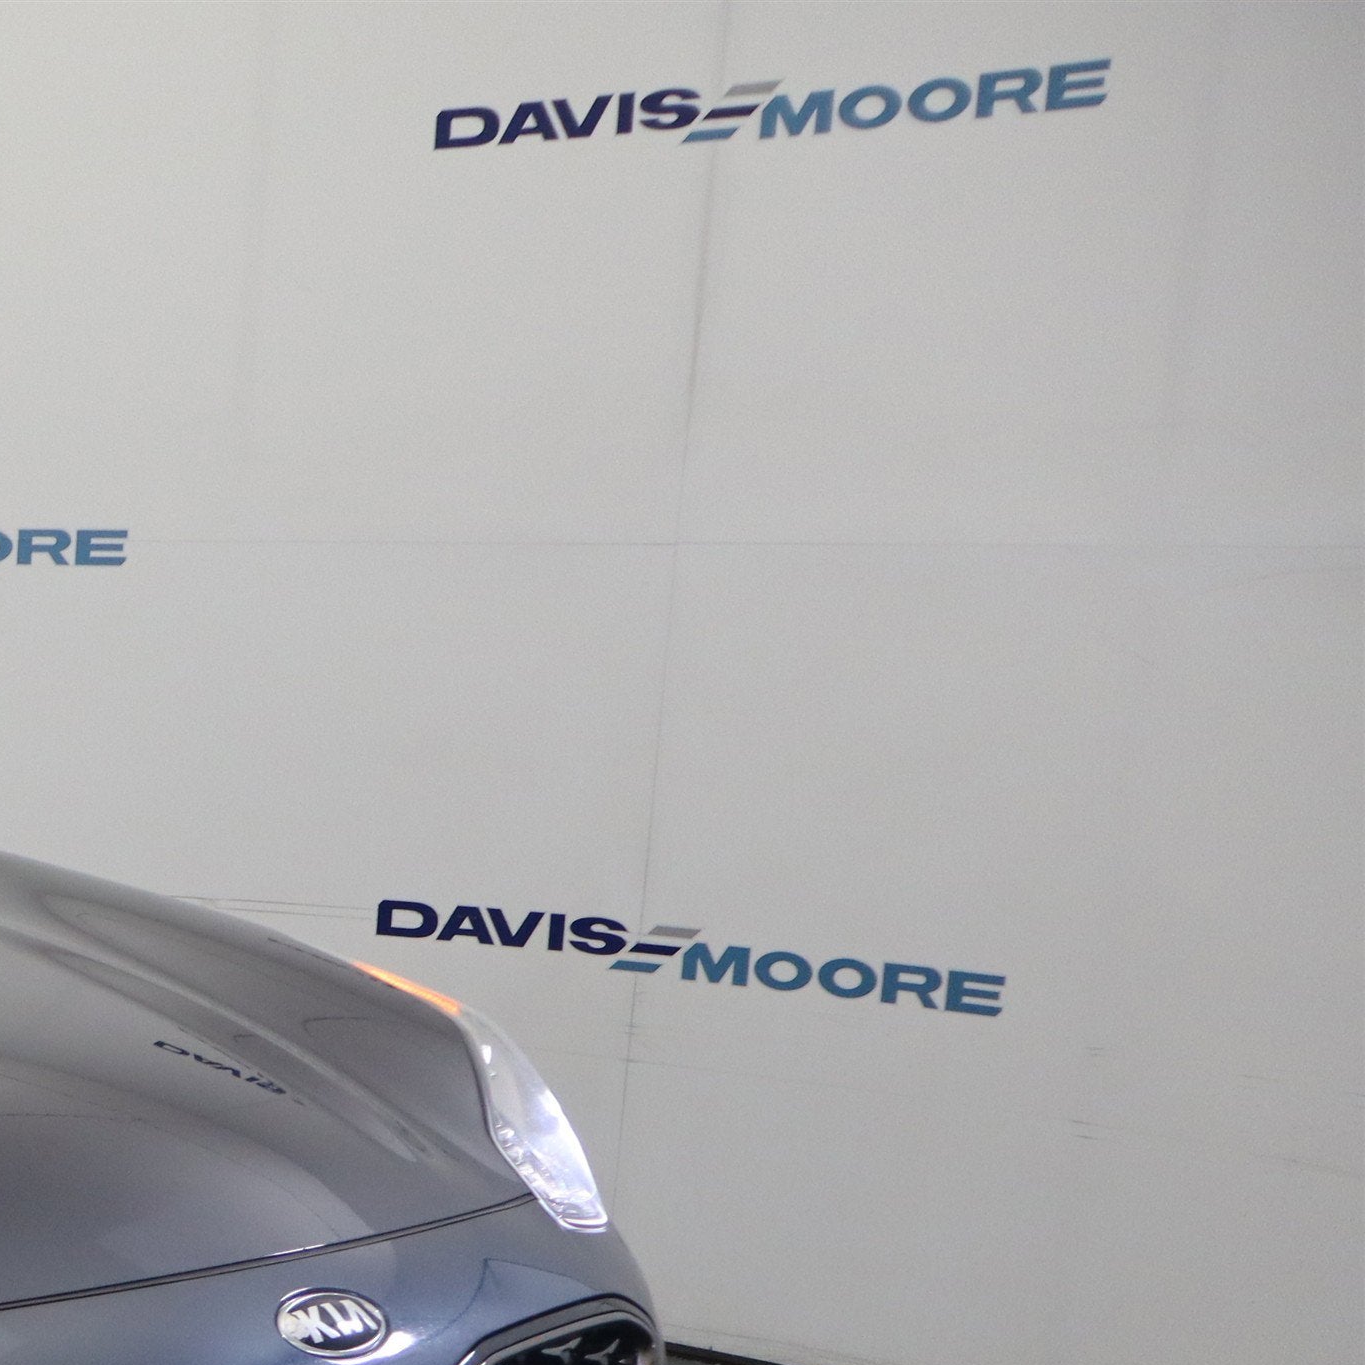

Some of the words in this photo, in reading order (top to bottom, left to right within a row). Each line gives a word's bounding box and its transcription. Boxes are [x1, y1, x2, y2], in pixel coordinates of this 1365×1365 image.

[434, 88, 703, 150] DAVIS
[760, 59, 1111, 139] MOORE
[376, 899, 627, 955] DAVIS
[681, 942, 1005, 1016] MOORE
[289, 1298, 379, 1345] KIA
